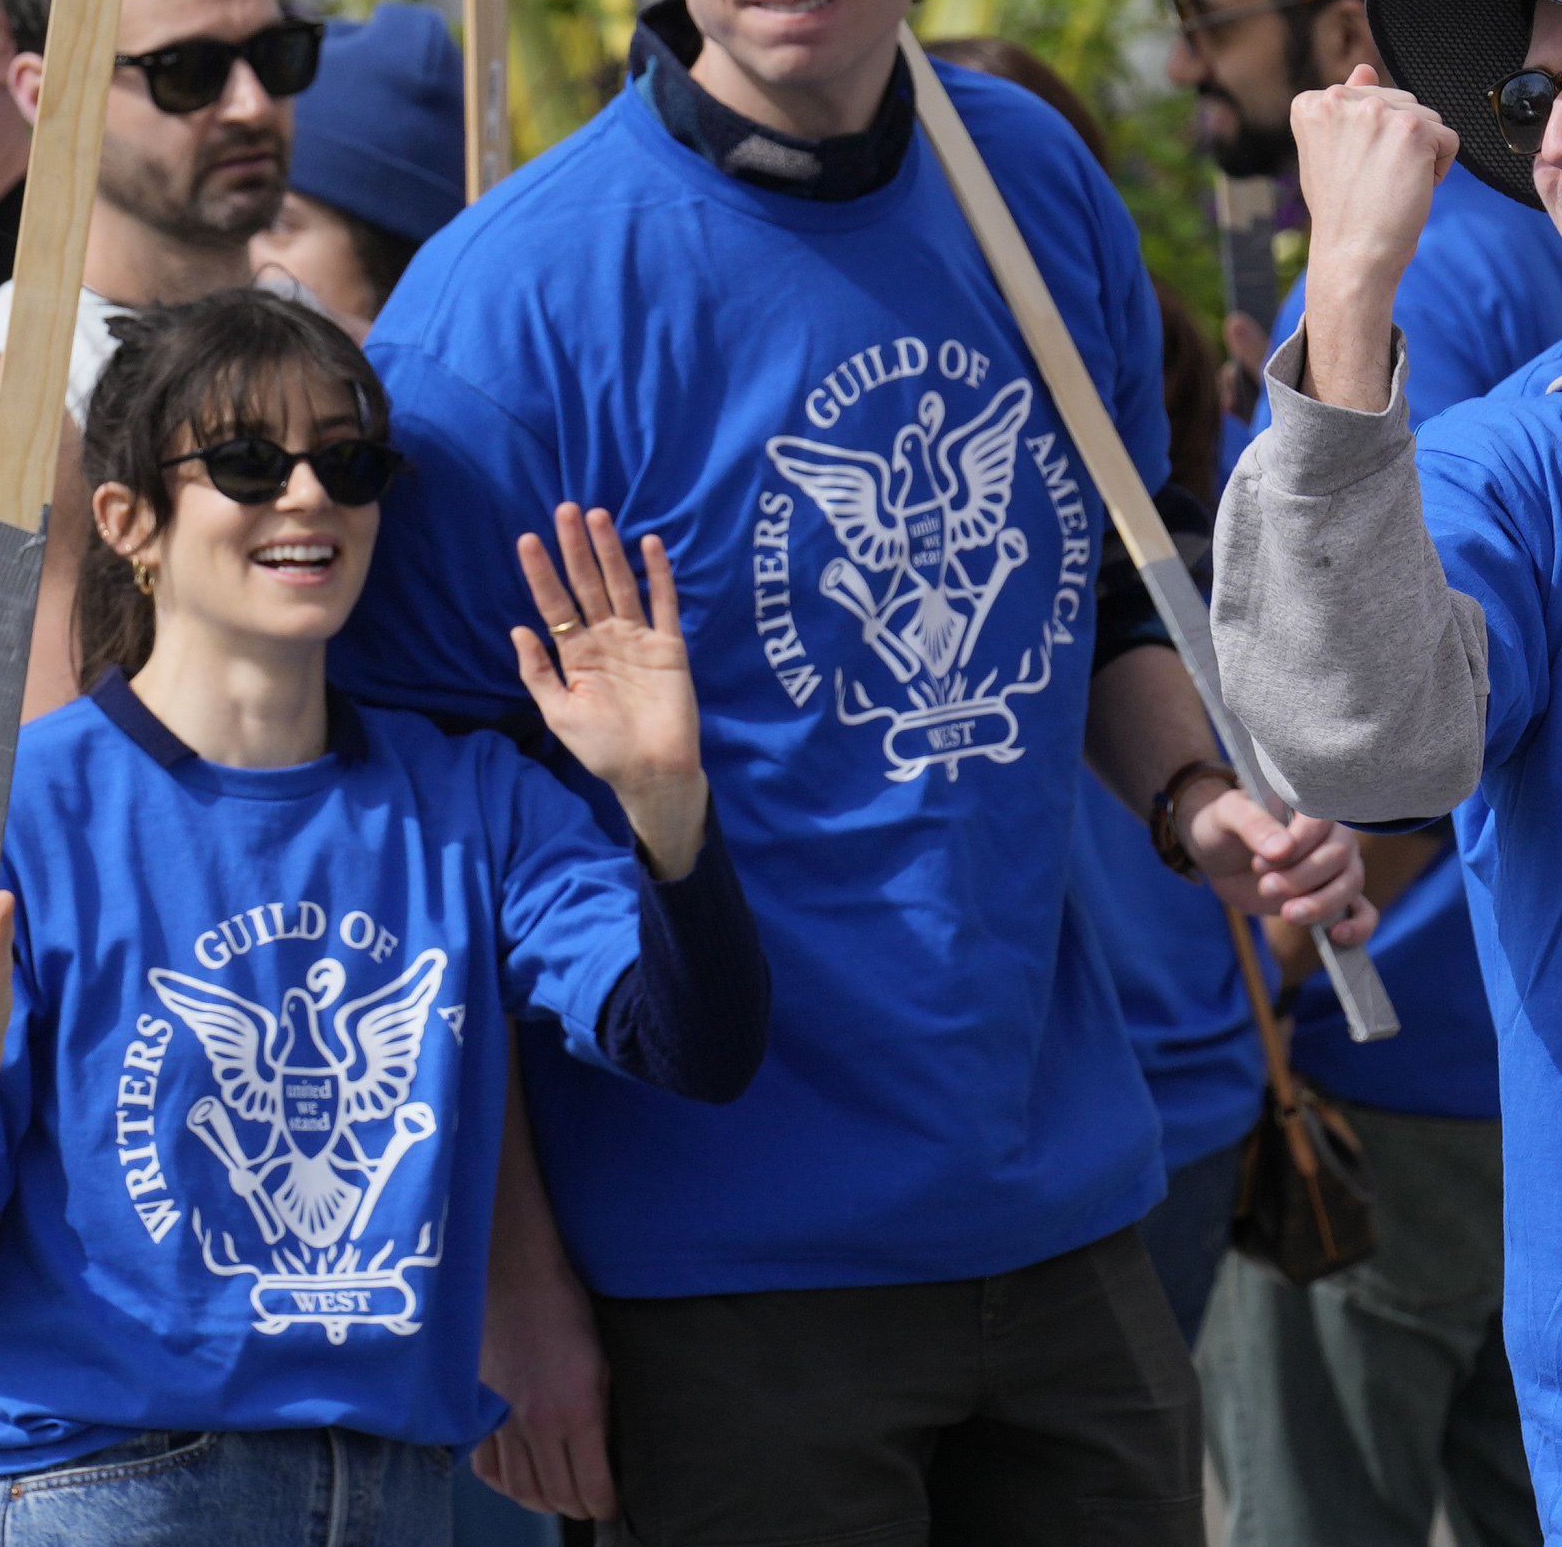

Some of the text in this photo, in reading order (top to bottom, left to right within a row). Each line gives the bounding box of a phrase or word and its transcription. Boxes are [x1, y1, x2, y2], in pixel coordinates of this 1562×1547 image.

[752, 336, 1090, 709] WRITERS GUILD OF AMERICA
[926, 720, 976, 751] WEST
[116, 900, 399, 1245] WRITERS GUILD OF
[285, 1079, 332, 1099] united
[296, 1101, 318, 1115] we
[288, 1111, 331, 1131] stand
[291, 1289, 372, 1314] WEST
